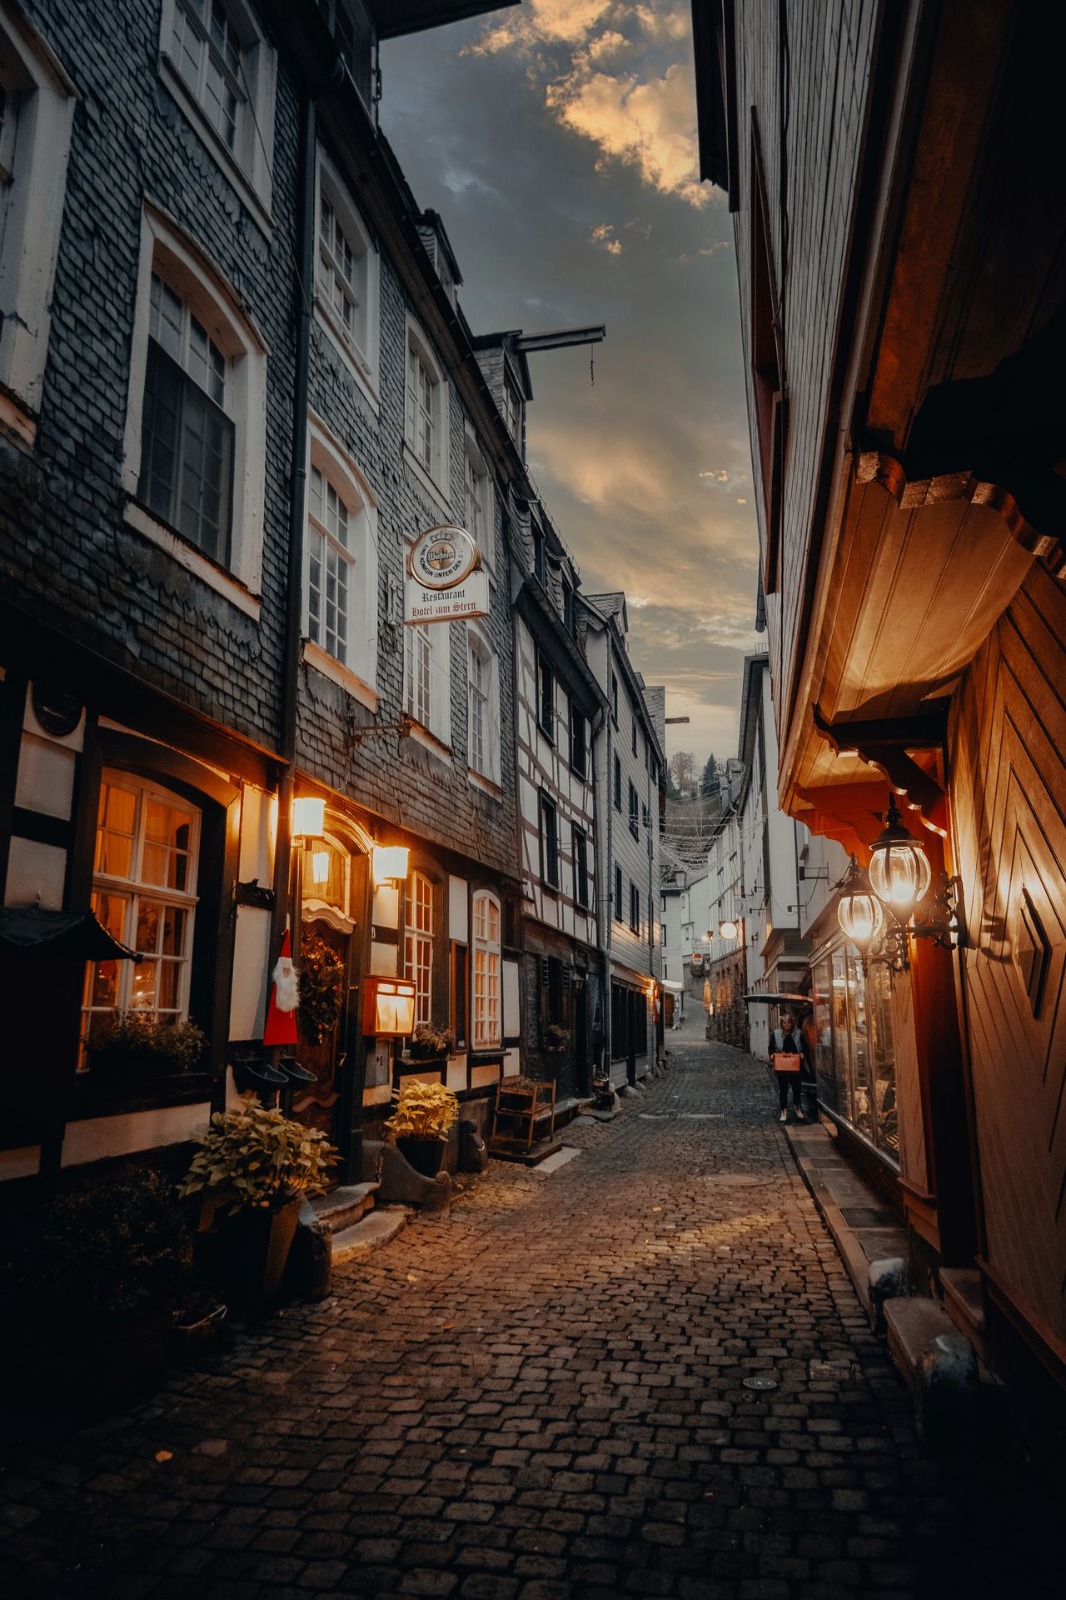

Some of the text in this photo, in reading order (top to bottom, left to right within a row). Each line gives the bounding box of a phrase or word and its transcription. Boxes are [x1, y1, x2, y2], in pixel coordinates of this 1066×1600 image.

[434, 570, 453, 578] UNTER
[422, 590, 465, 602] Restaurant
[412, 602, 476, 617] Hotel zum Stern
